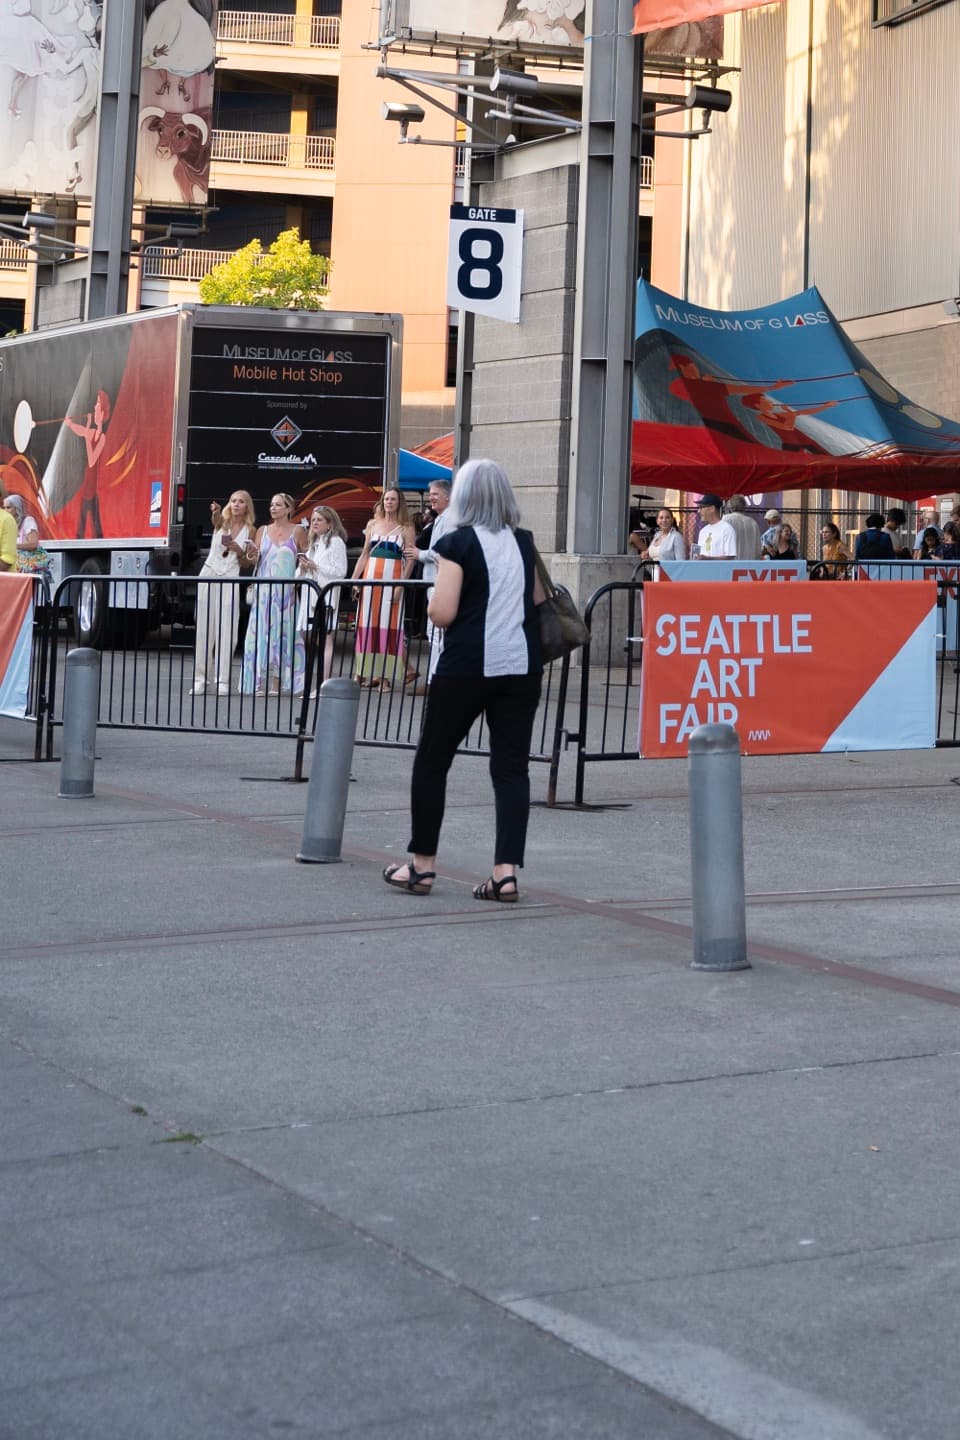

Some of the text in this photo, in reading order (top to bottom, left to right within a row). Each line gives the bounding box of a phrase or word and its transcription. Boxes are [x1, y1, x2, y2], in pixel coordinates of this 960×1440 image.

[468, 207, 497, 221] GATE
[457, 227, 504, 300] 8
[655, 304, 830, 331] MUSEUM OF GLASS
[223, 344, 290, 360] MUSEUM
[291, 350, 307, 360] OF
[233, 365, 343, 384] Mobile Hot Shop
[656, 614, 813, 656] SEATTLE
[690, 658, 763, 698] ART
